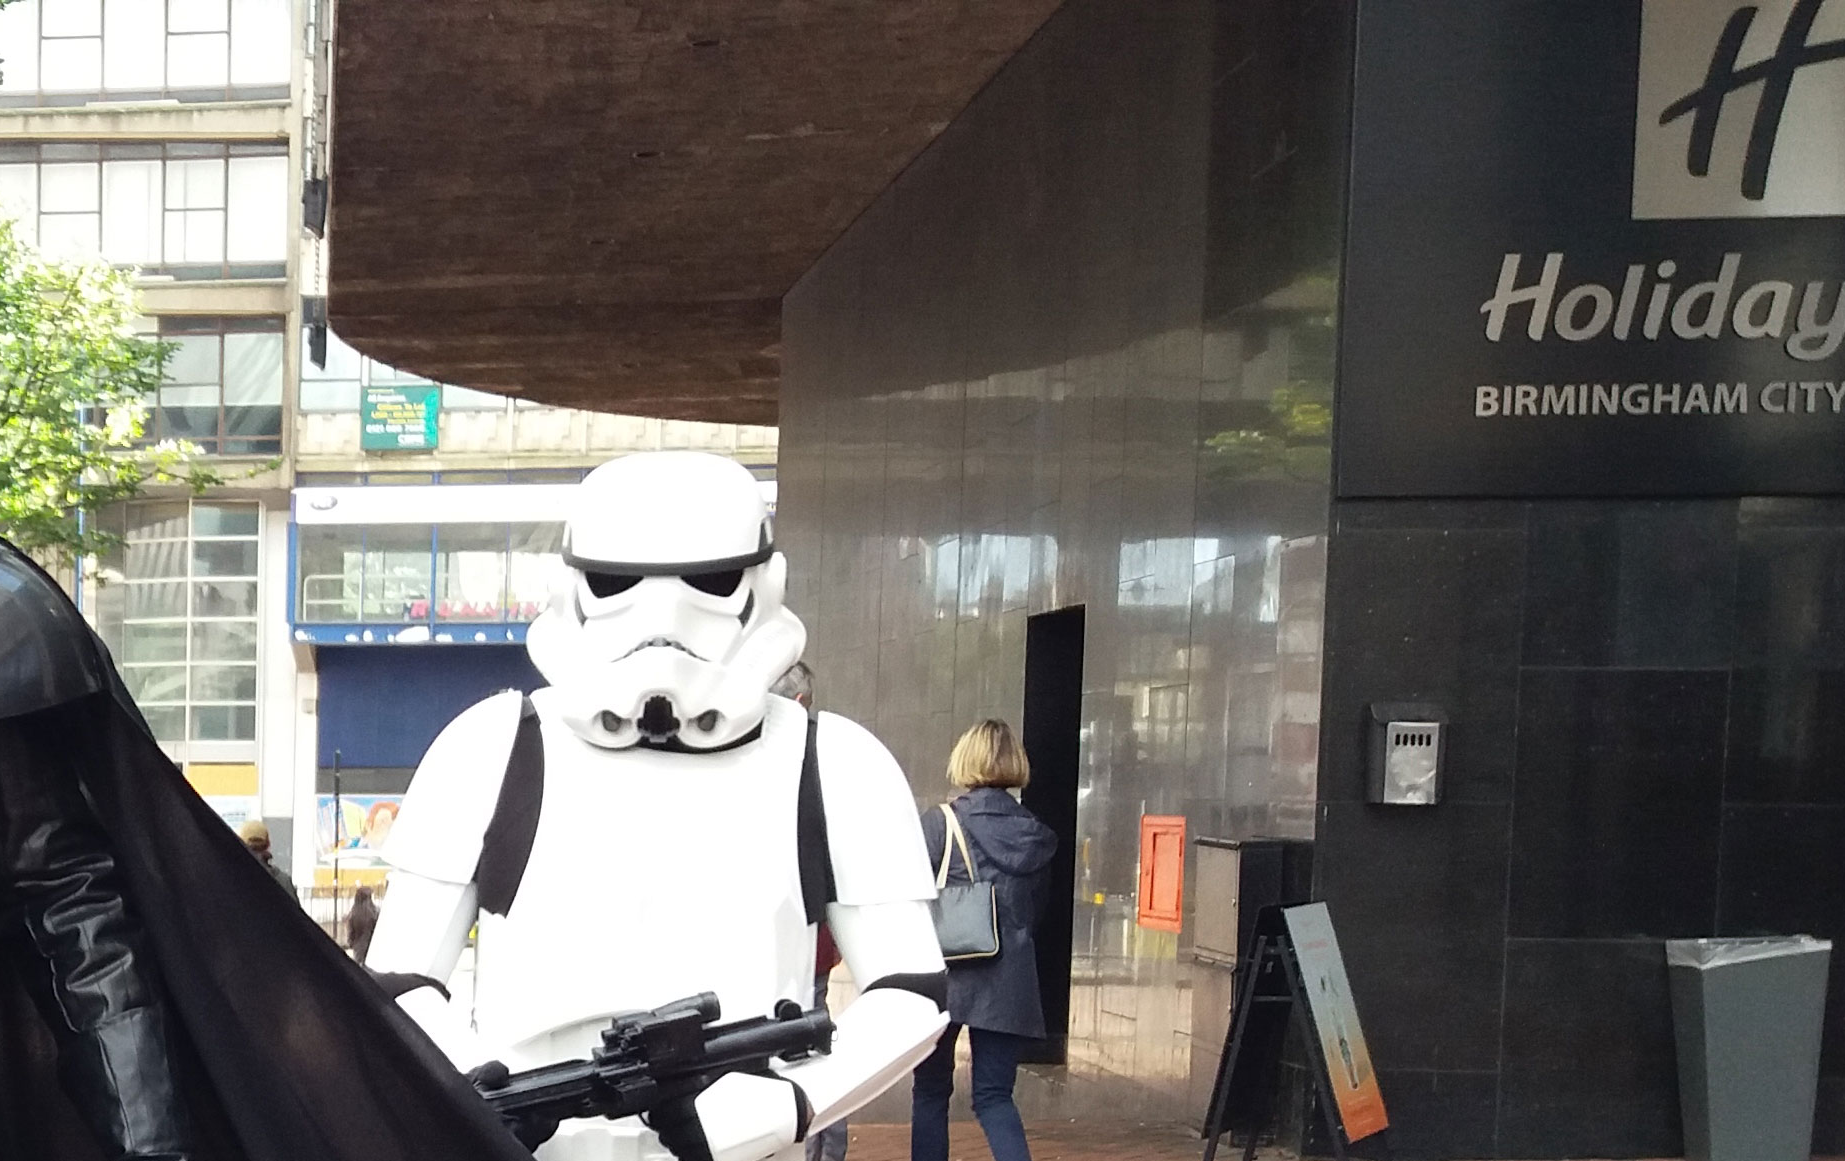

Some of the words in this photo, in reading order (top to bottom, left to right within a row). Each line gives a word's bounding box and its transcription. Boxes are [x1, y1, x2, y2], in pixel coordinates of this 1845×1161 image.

[1480, 252, 1845, 361] Holiday
[1474, 382, 1749, 418] BIRMINGHAM
[1760, 381, 1845, 415] CITY
